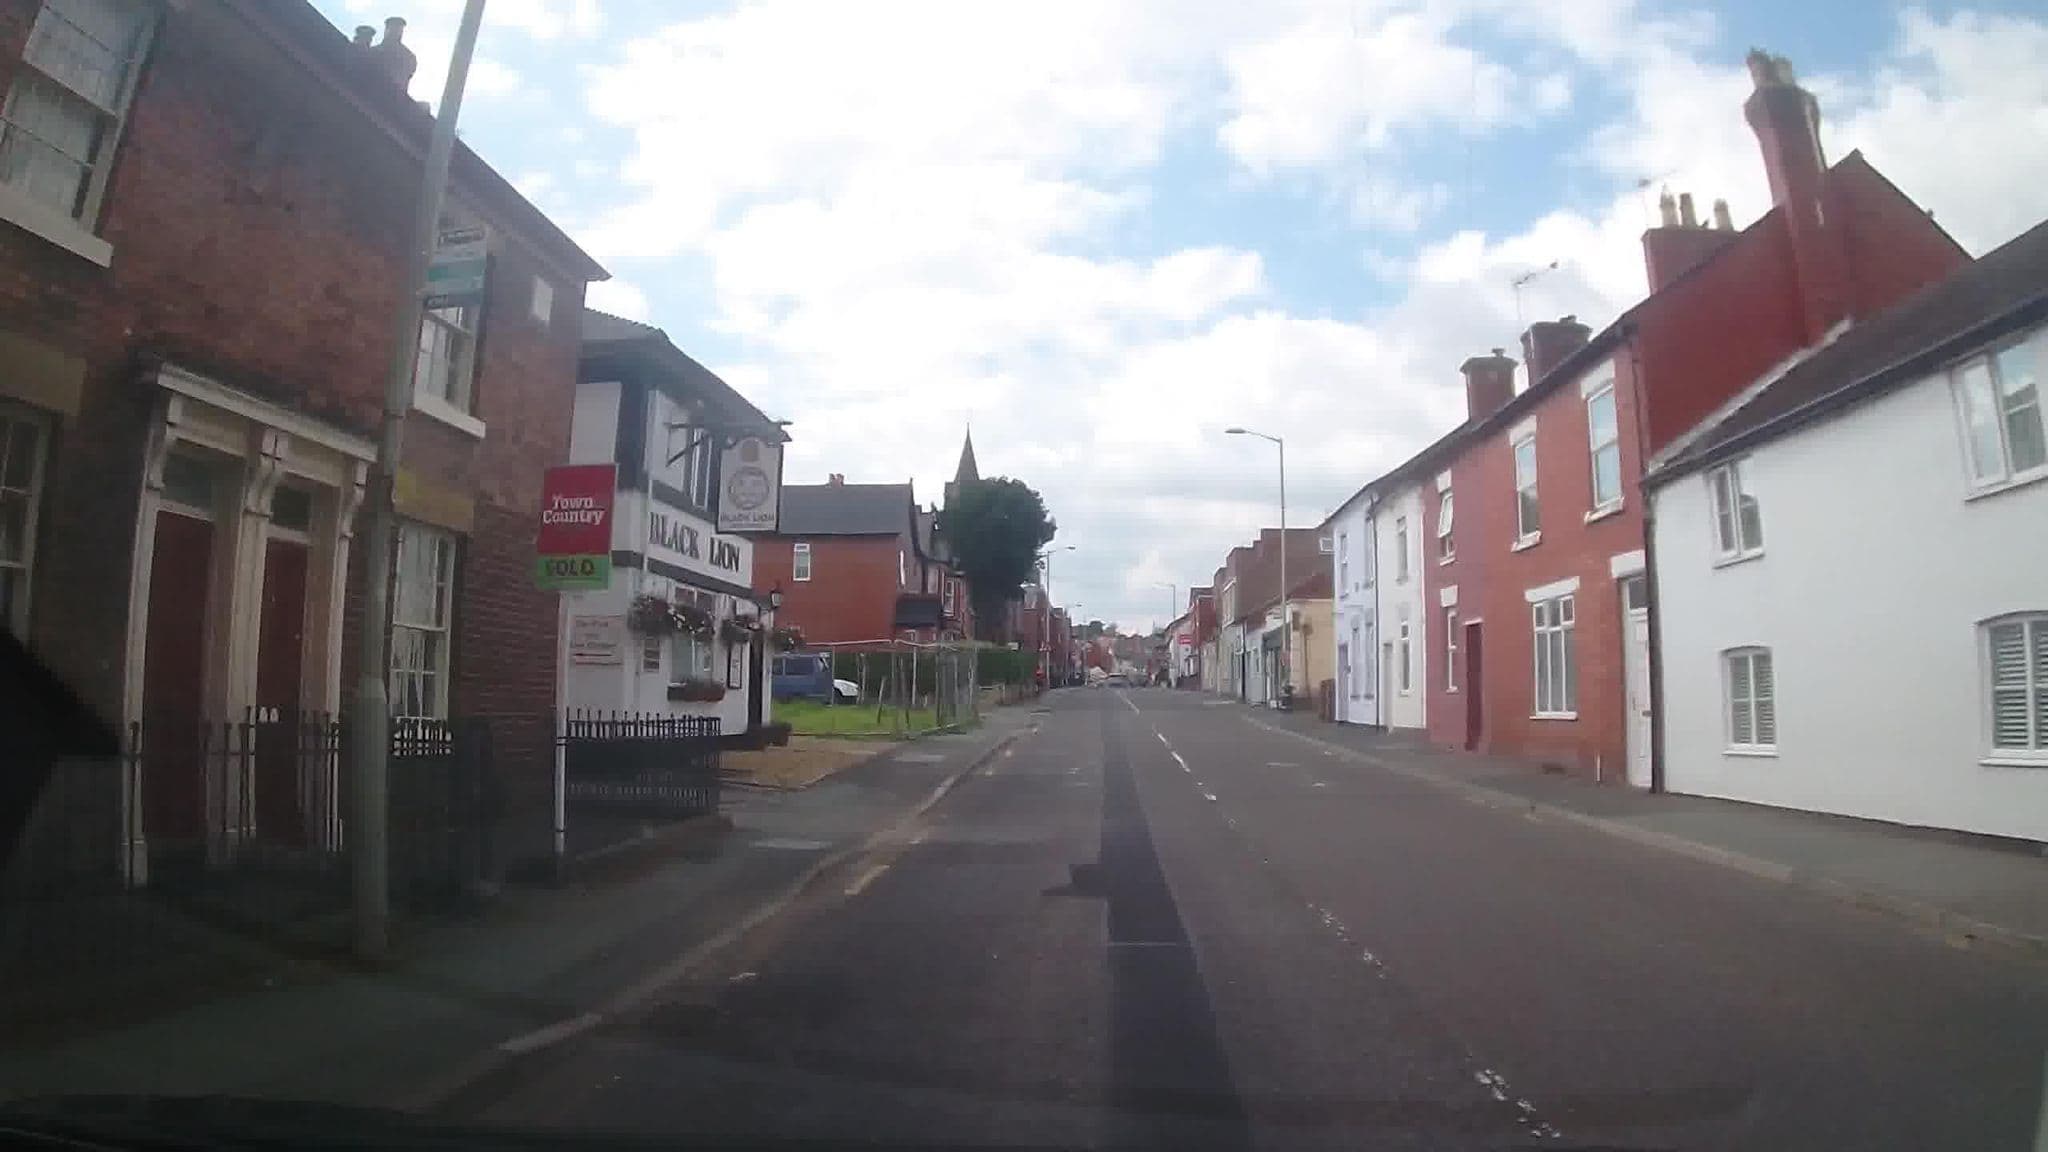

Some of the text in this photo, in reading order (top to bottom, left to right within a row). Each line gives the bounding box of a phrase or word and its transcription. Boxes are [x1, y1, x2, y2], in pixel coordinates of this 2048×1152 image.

[552, 495, 594, 510] Town
[543, 510, 605, 525] Country
[648, 512, 740, 573] BLACK LION
[545, 559, 595, 577] SOLD
